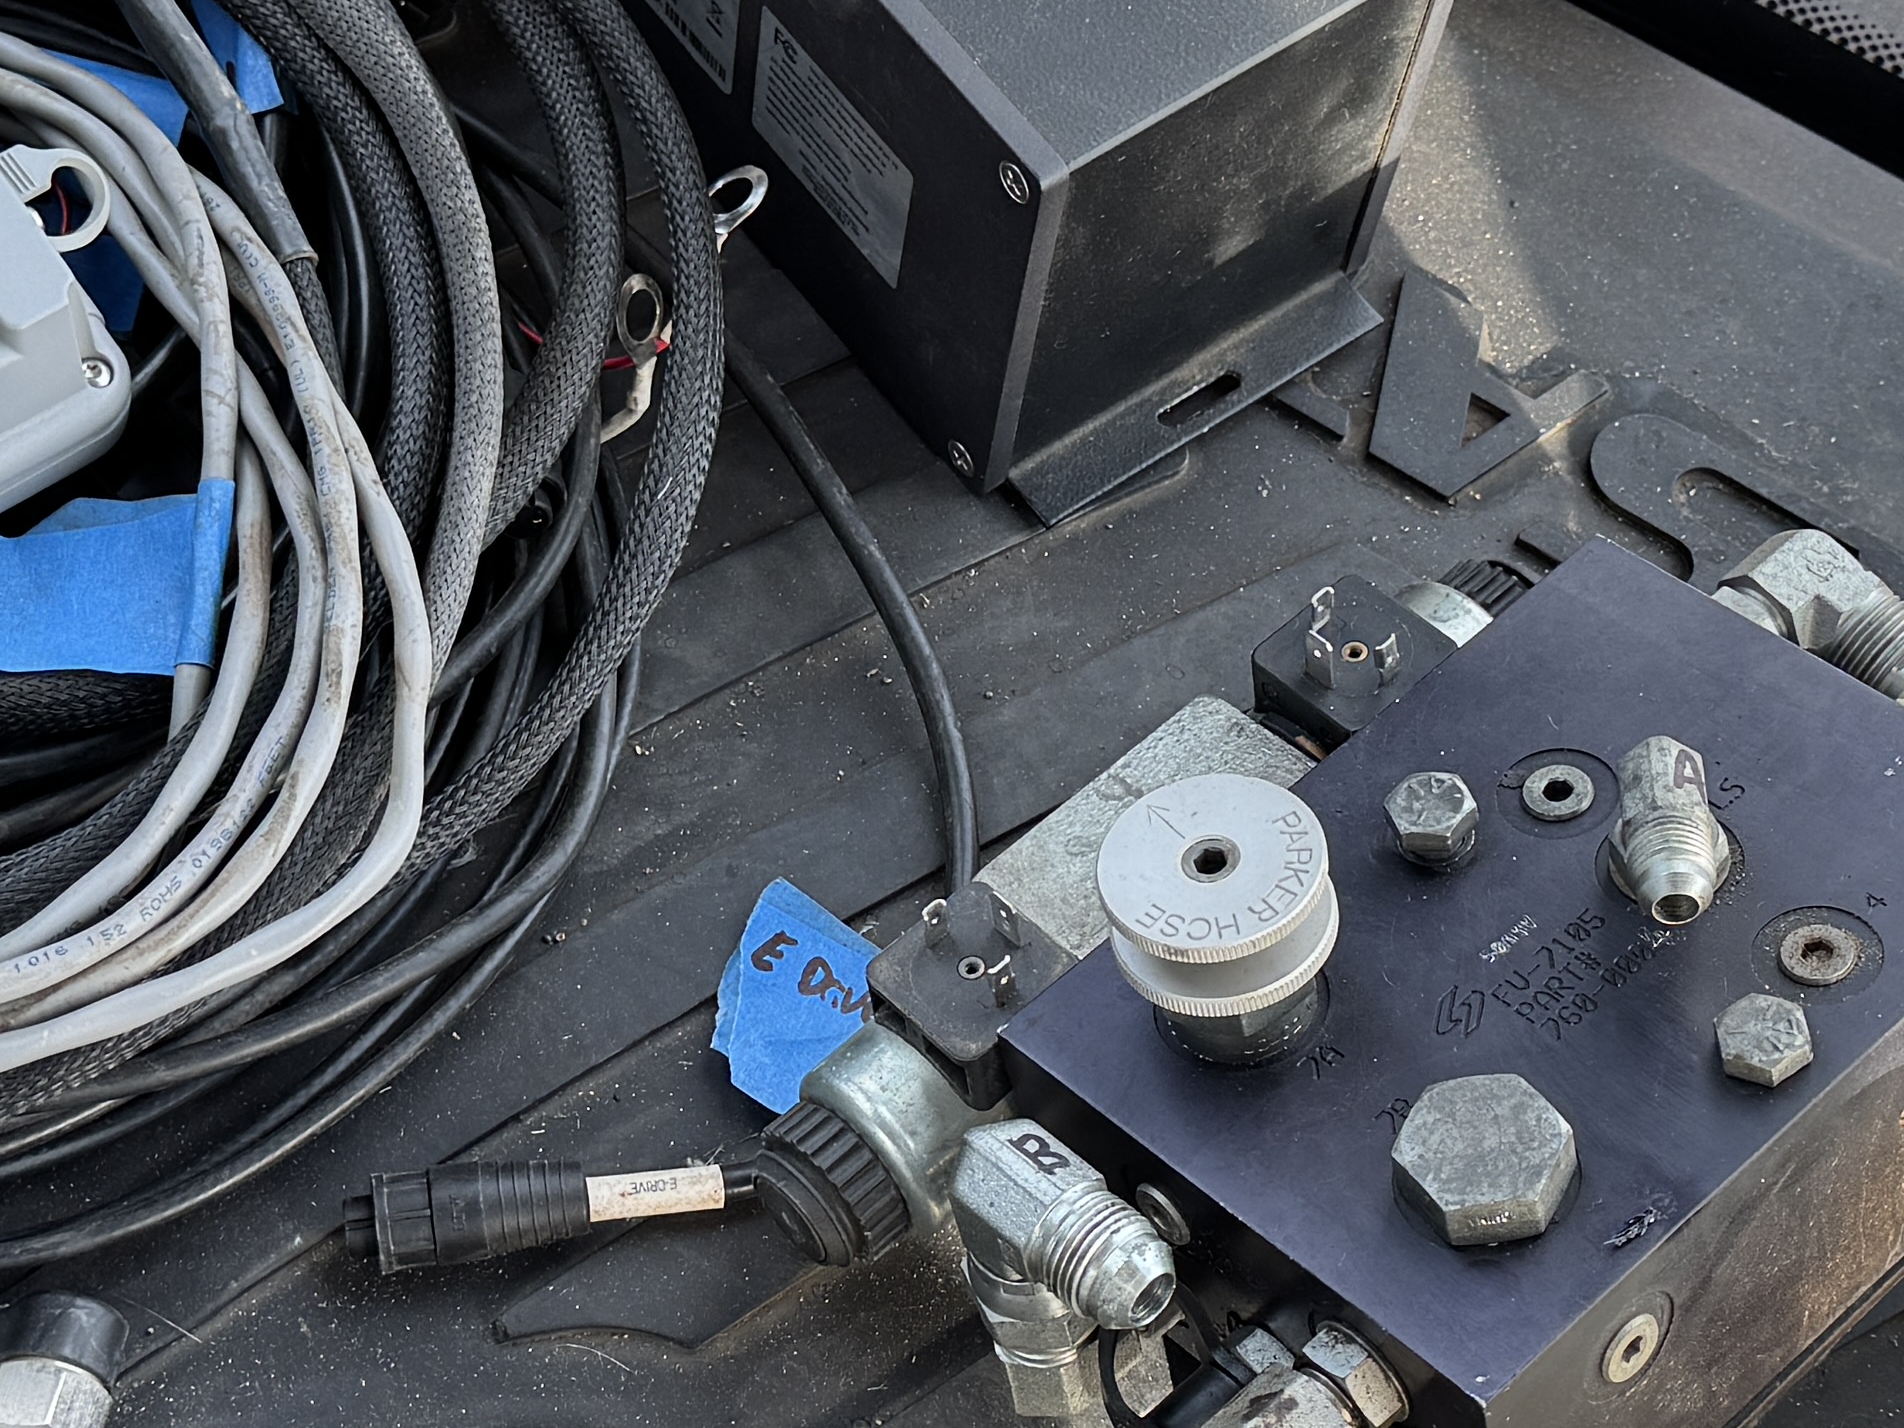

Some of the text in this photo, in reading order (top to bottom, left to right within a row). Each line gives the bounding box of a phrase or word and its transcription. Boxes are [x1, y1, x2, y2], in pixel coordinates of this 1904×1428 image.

[1672, 749, 1705, 791] A
[1134, 808, 1315, 943] PARKER HCSE
[1513, 951, 1603, 1025] PART#
[628, 1178, 679, 1197] E-DRIVE
